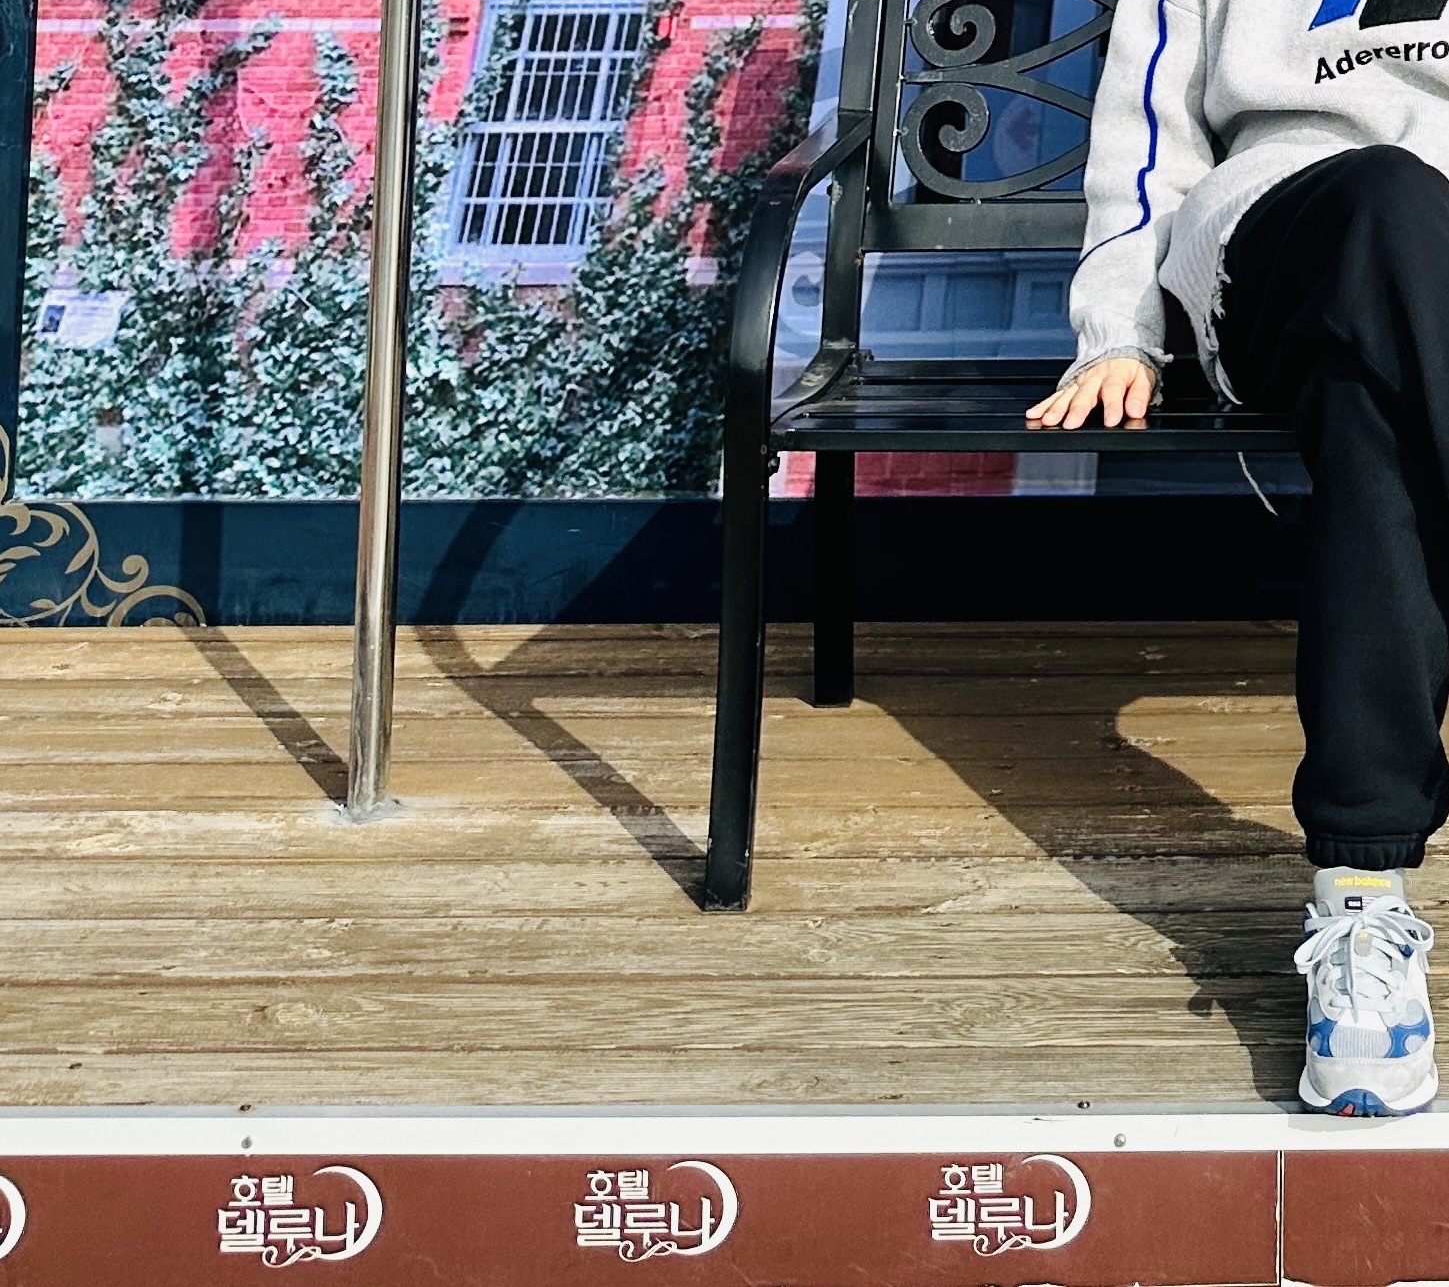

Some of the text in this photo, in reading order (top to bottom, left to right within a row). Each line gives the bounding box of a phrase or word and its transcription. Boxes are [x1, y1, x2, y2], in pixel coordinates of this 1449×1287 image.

[229, 1175, 293, 1206] 호텔
[585, 1170, 648, 1201] 호텔
[940, 1164, 1002, 1194] 호텔
[218, 1202, 379, 1267] 델루나
[574, 1197, 735, 1262] 델루나
[929, 1191, 1089, 1256] 델루나
